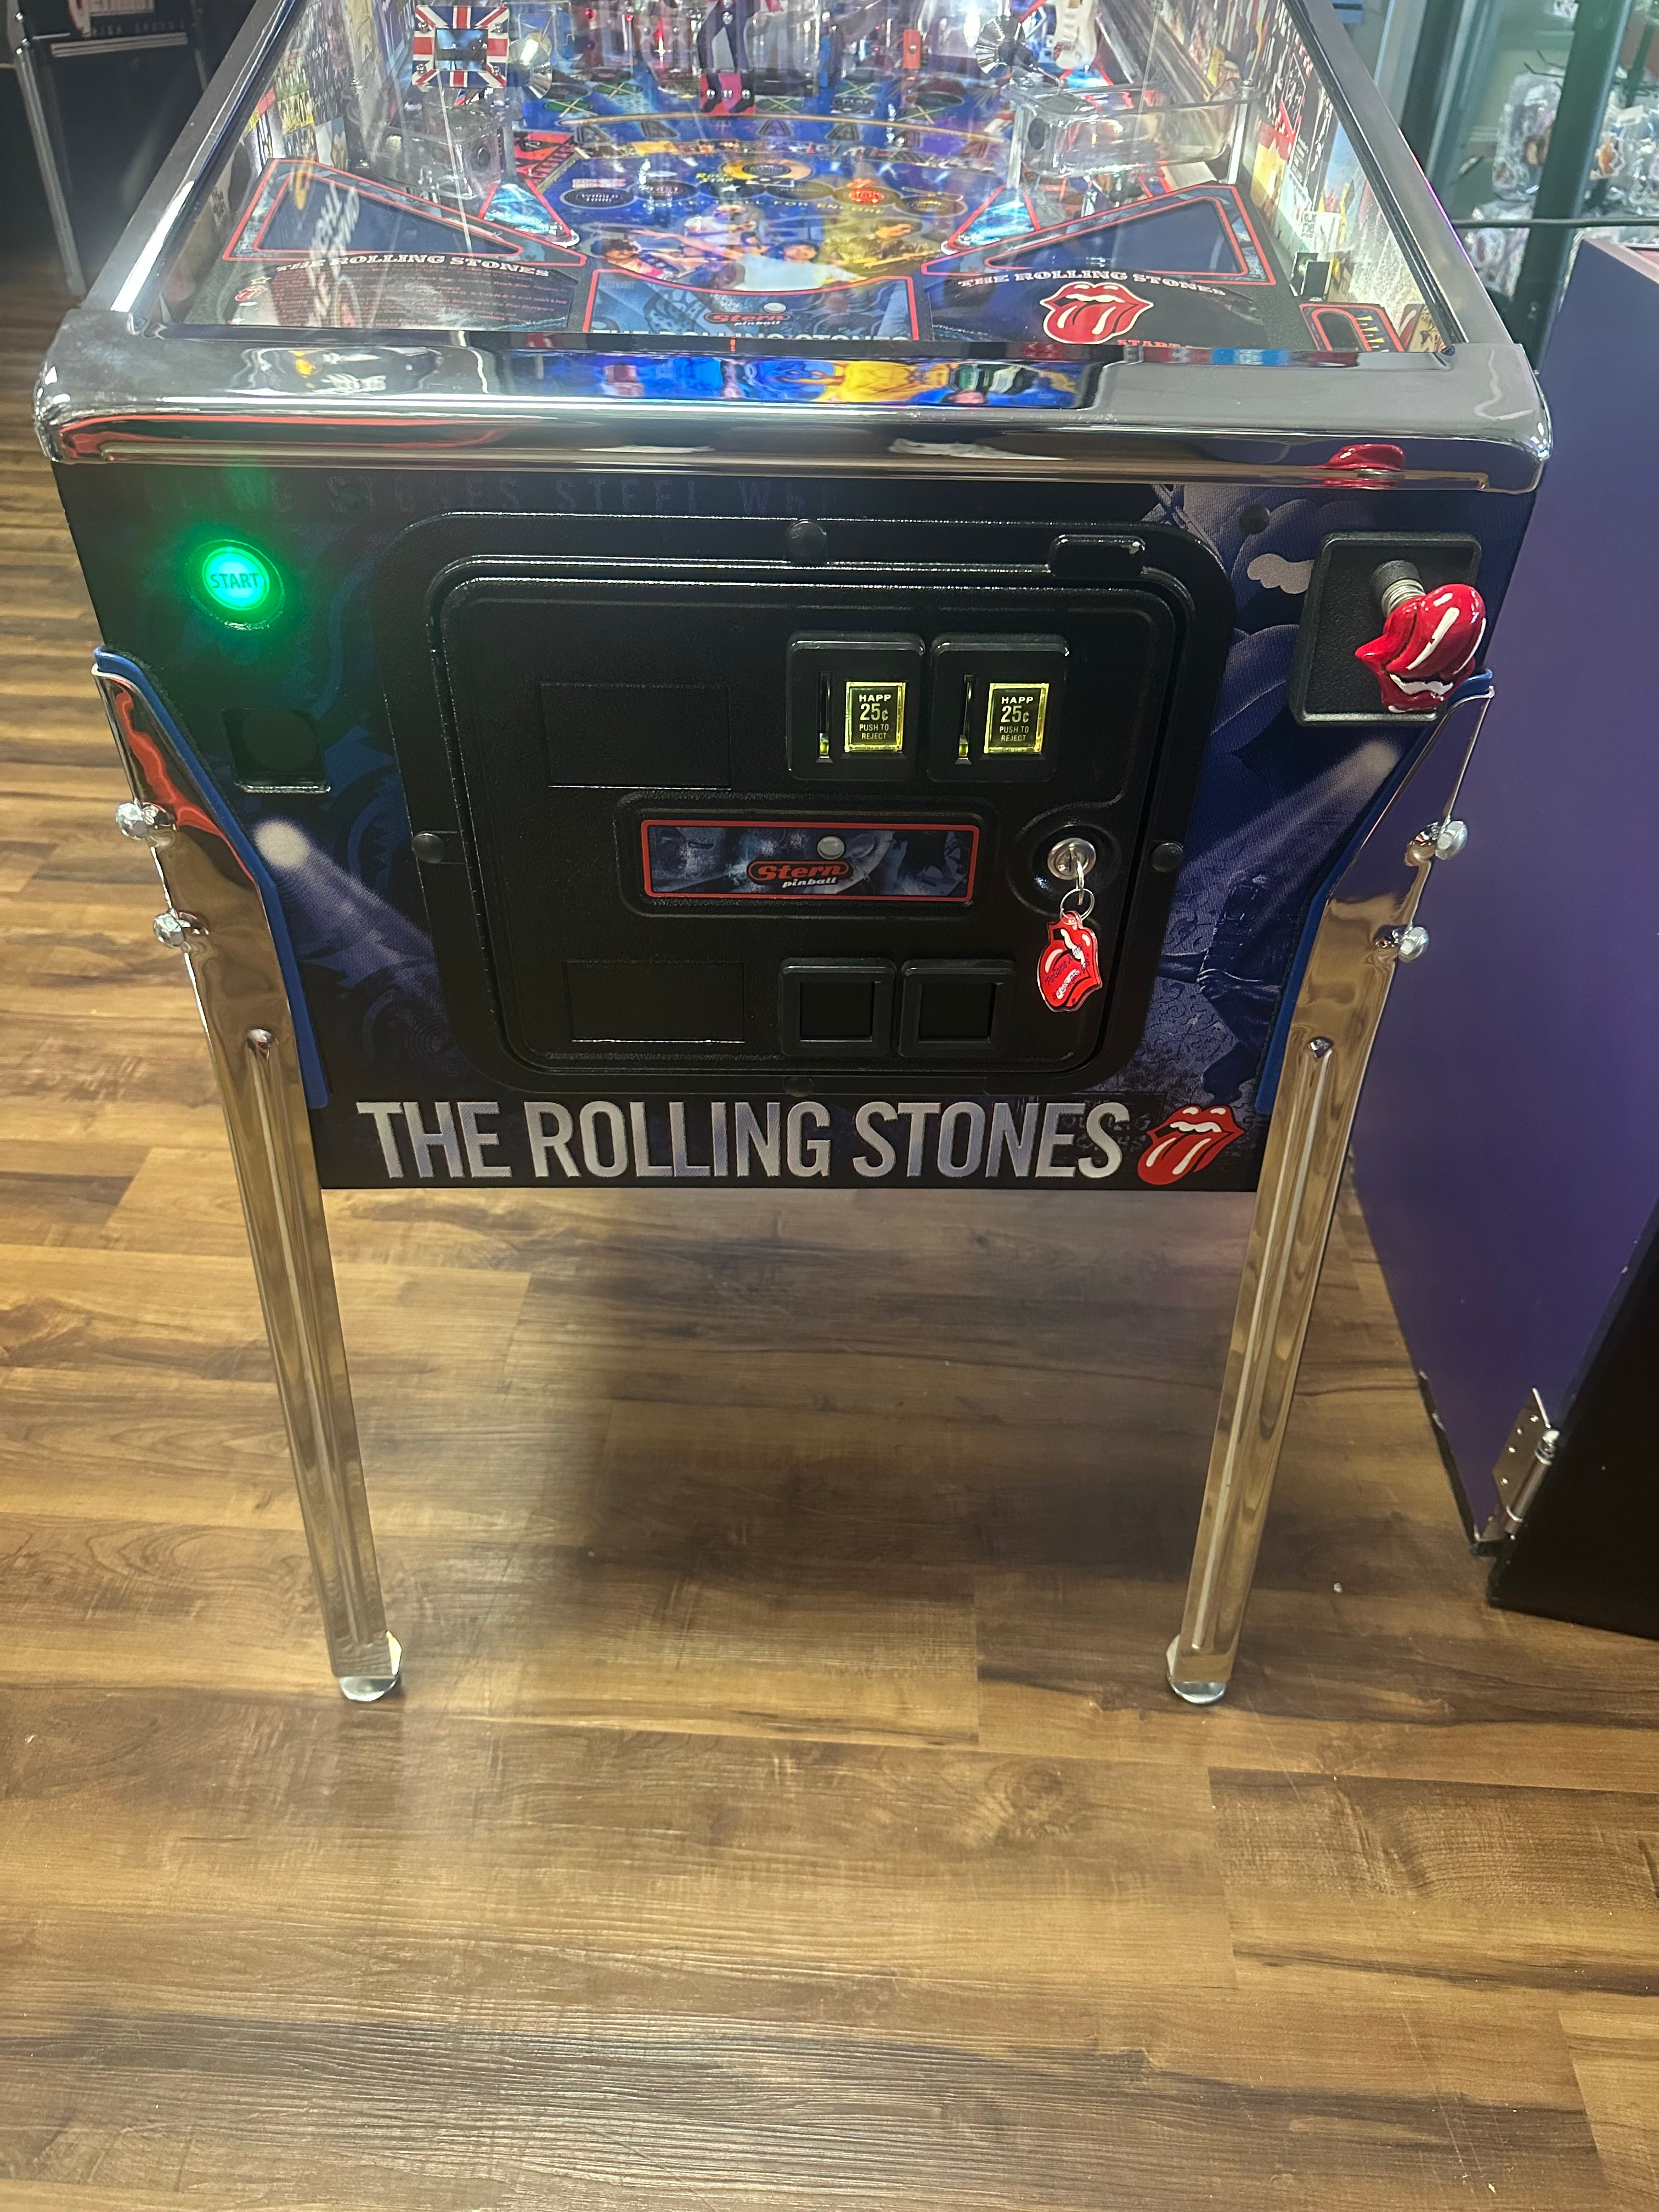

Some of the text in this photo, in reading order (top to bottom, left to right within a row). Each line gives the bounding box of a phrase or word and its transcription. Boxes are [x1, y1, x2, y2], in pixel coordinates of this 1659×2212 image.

[276, 259, 326, 272] THE
[329, 254, 445, 266] ROLLING
[450, 257, 549, 277] STONES
[957, 269, 1226, 296] THE ROLLING STONES
[713, 314, 786, 323] Stern
[210, 573, 259, 589] START
[859, 694, 891, 702] HAPP
[860, 703, 888, 722] 25¢
[1001, 705, 1029, 724] 25¢
[757, 864, 843, 881] Stern
[782, 877, 838, 888] pinball
[356, 1101, 1130, 1178] THE ROLLING STONES
